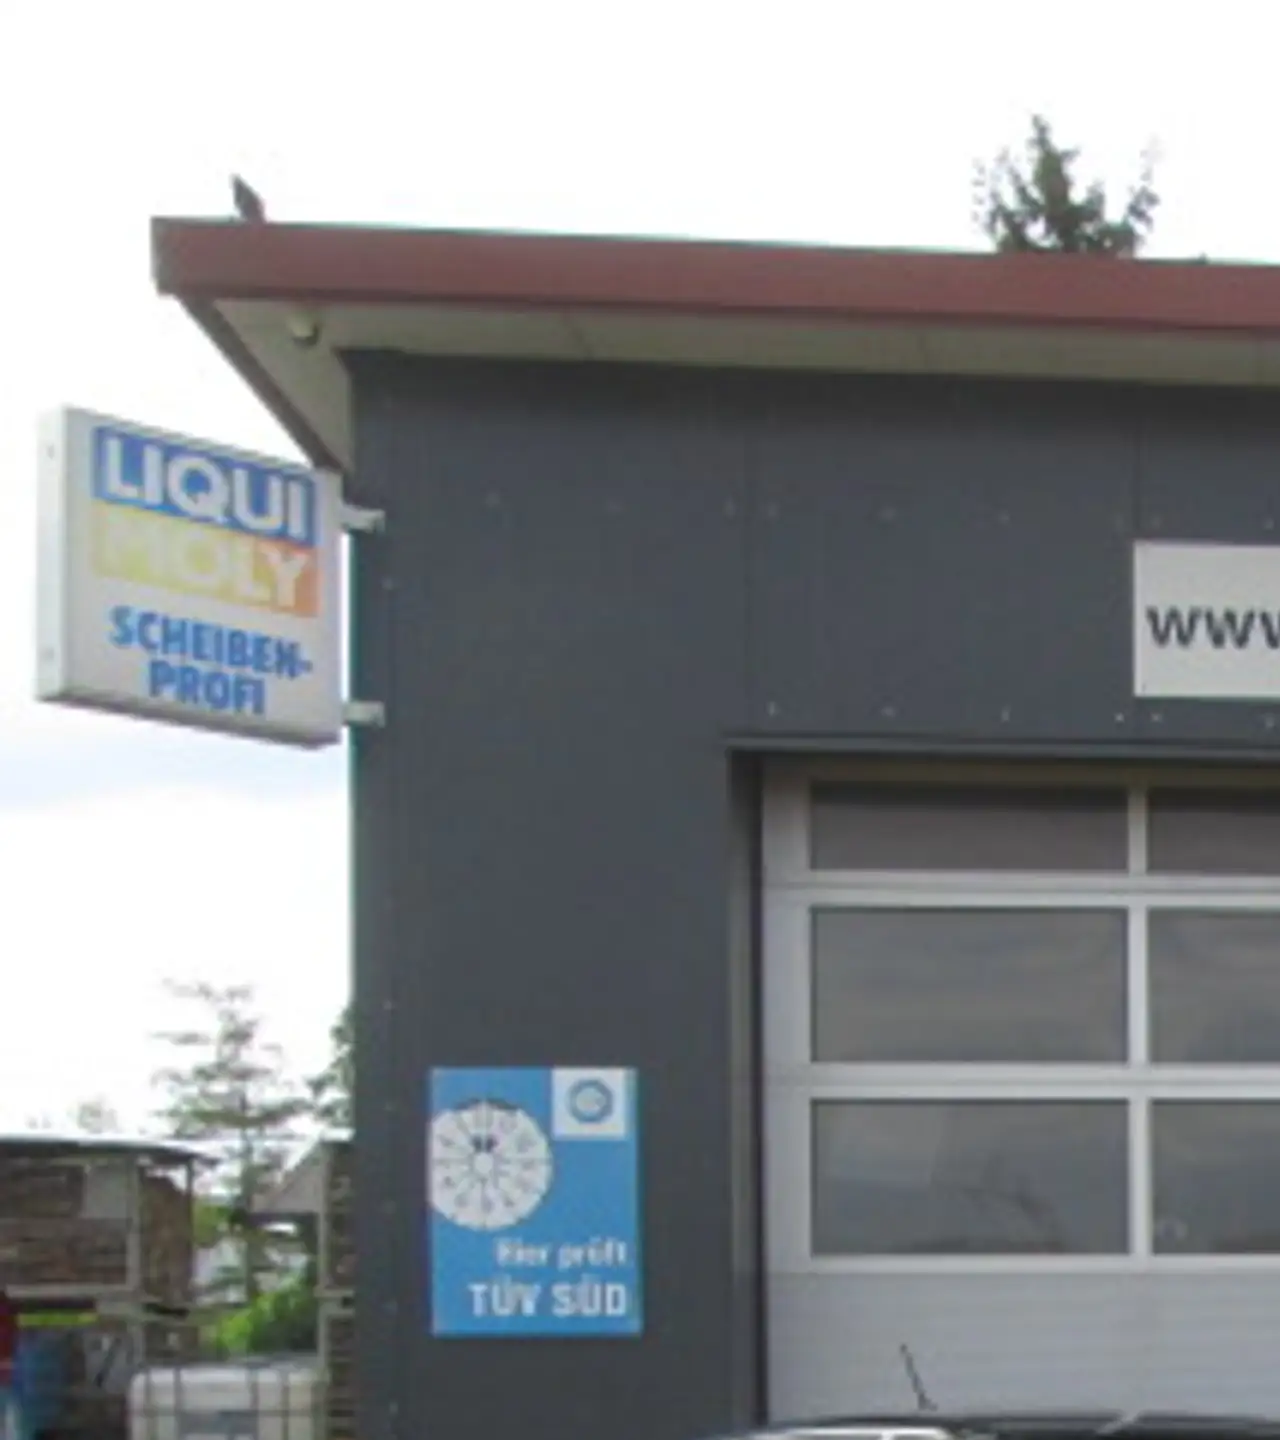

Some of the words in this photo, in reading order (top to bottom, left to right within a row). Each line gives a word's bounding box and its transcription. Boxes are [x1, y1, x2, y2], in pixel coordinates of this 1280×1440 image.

[104, 436, 309, 541] LIQUI
[108, 604, 313, 680] SCHEIBEN-
[148, 659, 265, 715] PROFI
[467, 1273, 542, 1317] TÜV
[551, 1273, 627, 1317] SÜD
